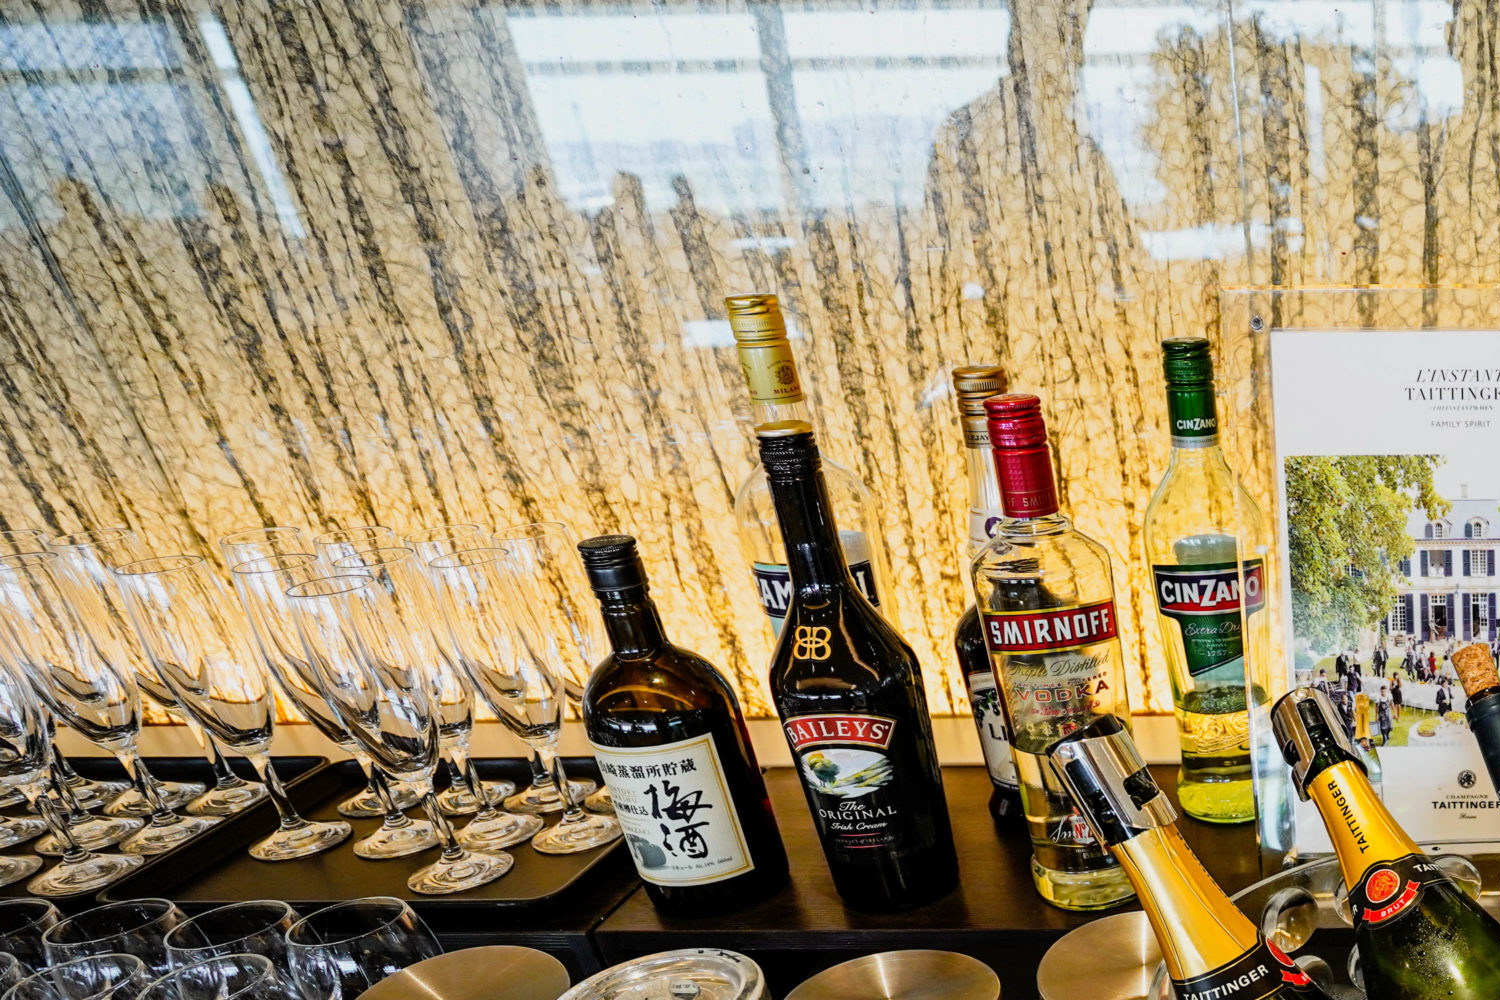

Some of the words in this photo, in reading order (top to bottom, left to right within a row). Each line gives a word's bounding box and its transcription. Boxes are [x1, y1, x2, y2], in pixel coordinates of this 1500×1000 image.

[1176, 417, 1216, 430] CINZANO
[1430, 420, 1461, 428] FAMILY
[1464, 420, 1491, 428] SPIRIT
[1160, 577, 1260, 608] CINZANO
[990, 608, 1109, 646] SMIRNOFF
[1184, 621, 1218, 637] Extra
[1051, 648, 1111, 677] Distilled
[1015, 679, 1110, 703] VODKA
[786, 720, 885, 744] BAILEYS
[818, 805, 897, 821] ORIGINAL
[839, 801, 866, 812] The
[831, 822, 853, 831] Irish
[853, 821, 888, 831] Cream
[1328, 780, 1370, 854] TAITTINGER
[1380, 899, 1406, 918] BRUT
